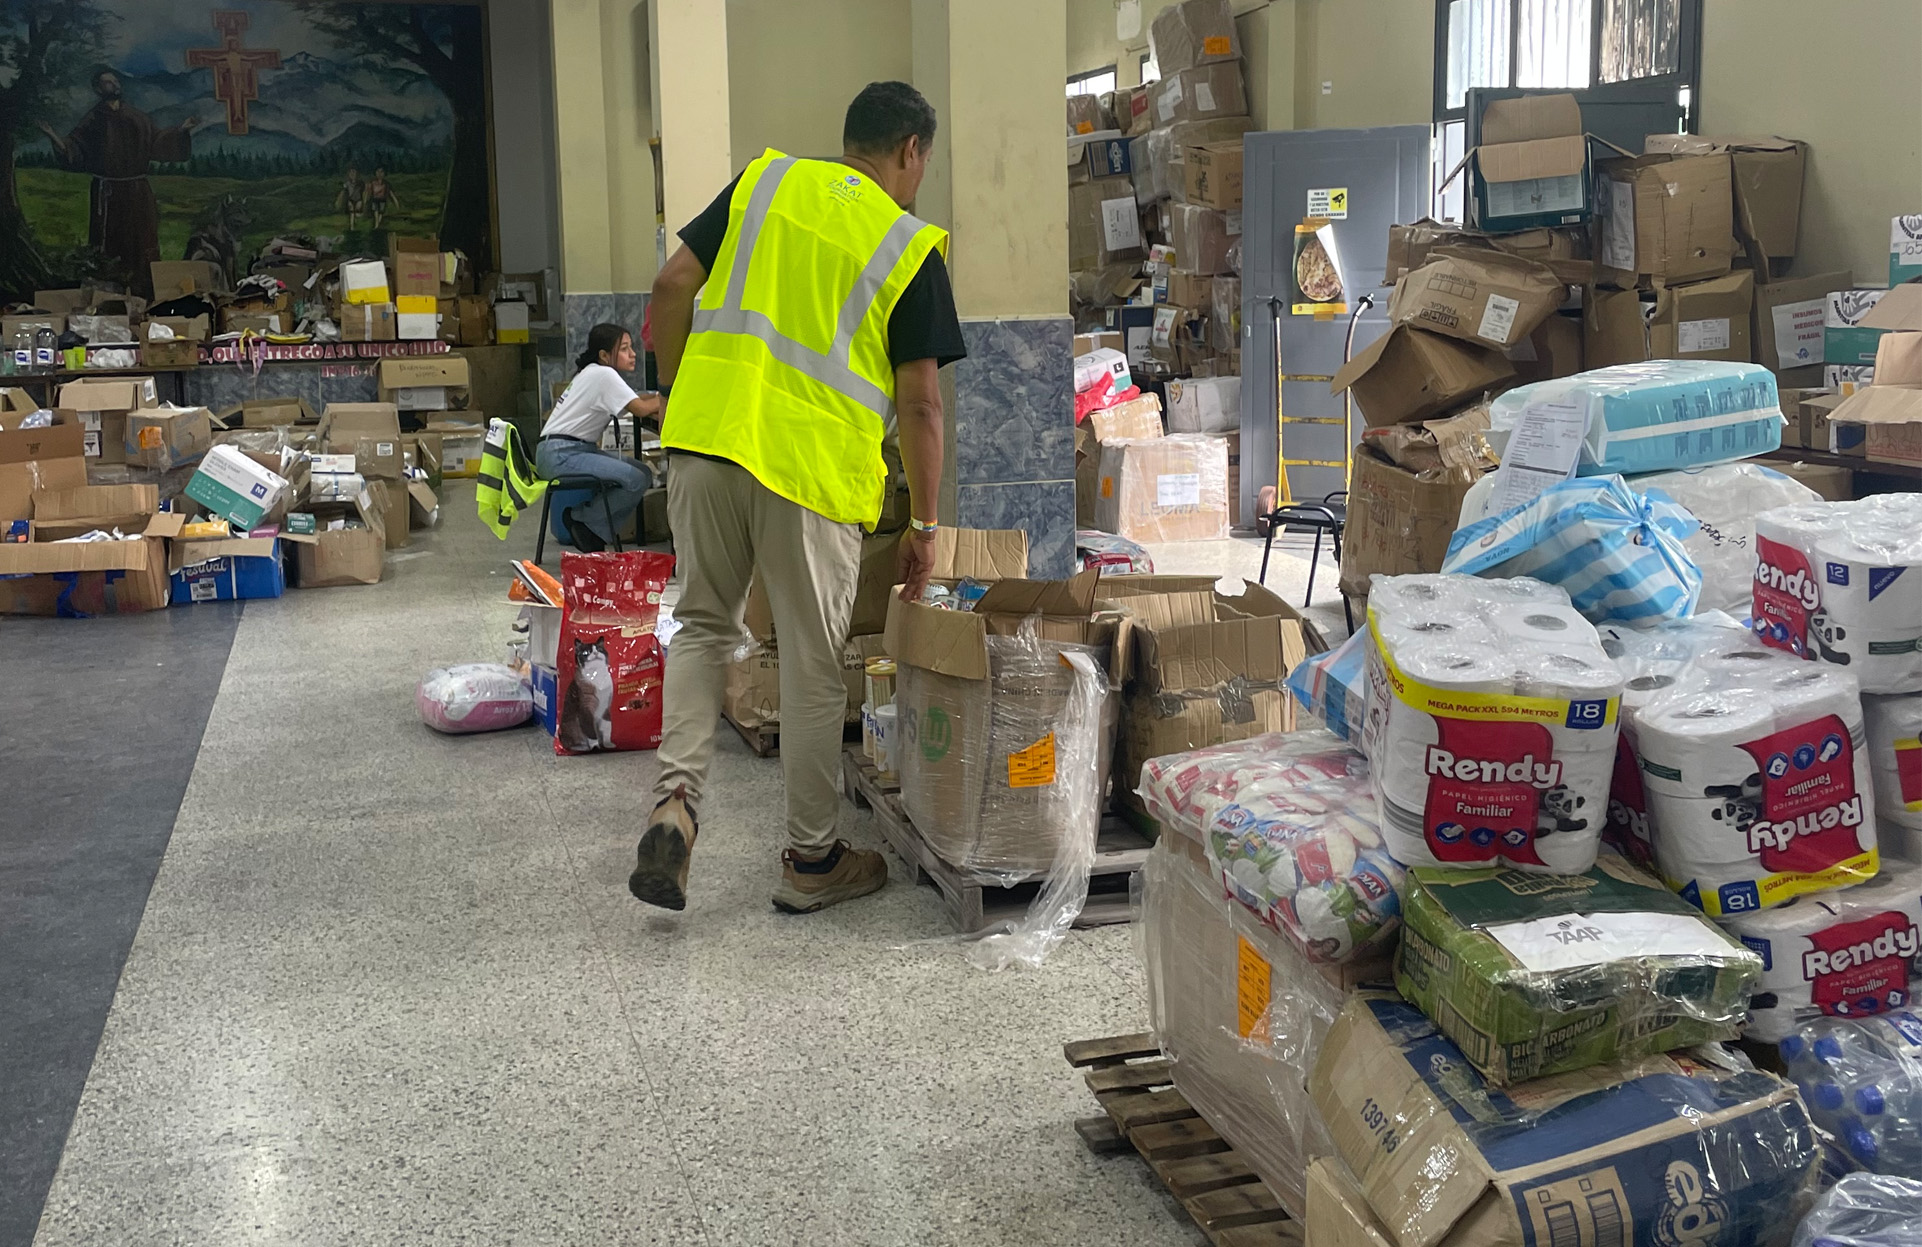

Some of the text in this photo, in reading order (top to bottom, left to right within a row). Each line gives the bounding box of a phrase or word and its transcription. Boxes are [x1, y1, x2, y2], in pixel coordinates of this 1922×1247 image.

[828, 180, 863, 198] ZAKAT
[1792, 308, 1823, 319] INSUMOS
[254, 486, 265, 496] M
[1829, 564, 1844, 578] 12
[1874, 570, 1895, 590] nuevo
[1427, 699, 1560, 718] MEGA PACK XXL 594 METROS
[1574, 702, 1600, 719] 18
[1428, 747, 1561, 789] Rendy
[1785, 773, 1831, 798] Familiar
[1442, 790, 1473, 801] PAPEL
[1456, 802, 1514, 818] Familiar
[1749, 796, 1861, 851] Rendy
[1763, 874, 1794, 894] METROS
[1727, 893, 1755, 910] 18
[1545, 926, 1604, 946] TAAP
[1805, 929, 1918, 978] Rendy
[1843, 978, 1889, 995] Familiar
